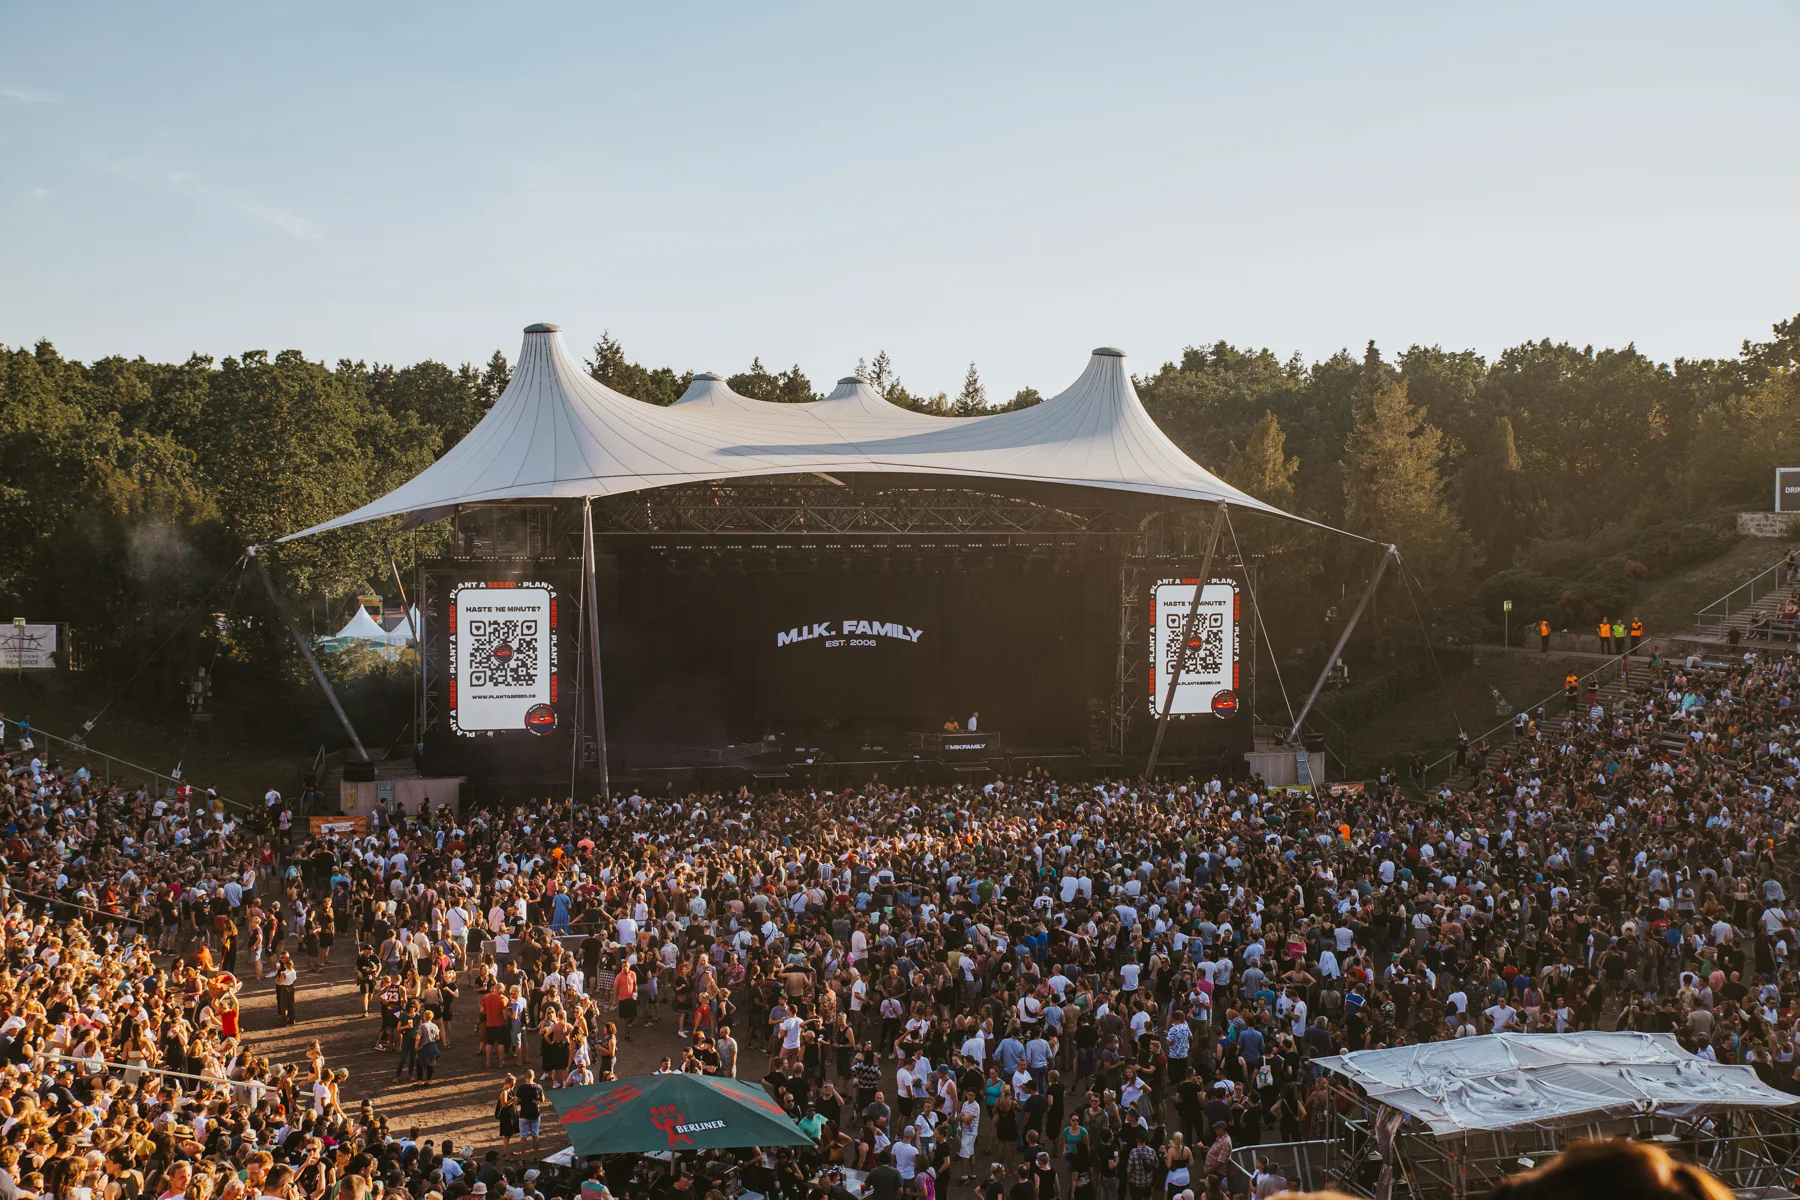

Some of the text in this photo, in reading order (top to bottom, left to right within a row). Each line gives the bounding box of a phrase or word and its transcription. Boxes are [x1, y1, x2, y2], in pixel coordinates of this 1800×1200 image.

[449, 581, 477, 599] PLANT
[479, 581, 486, 589] A
[523, 581, 554, 591] PLANT
[1150, 578, 1174, 595] PLANT
[1211, 578, 1237, 587] PLANT
[550, 591, 557, 599] A
[777, 620, 923, 647] M.I.K. FAMILY
[550, 635, 558, 664] PLANT
[449, 643, 457, 674] PLANT
[450, 709, 457, 717] A
[450, 719, 476, 738] PLANT
[675, 1120, 726, 1134] BERLINER
